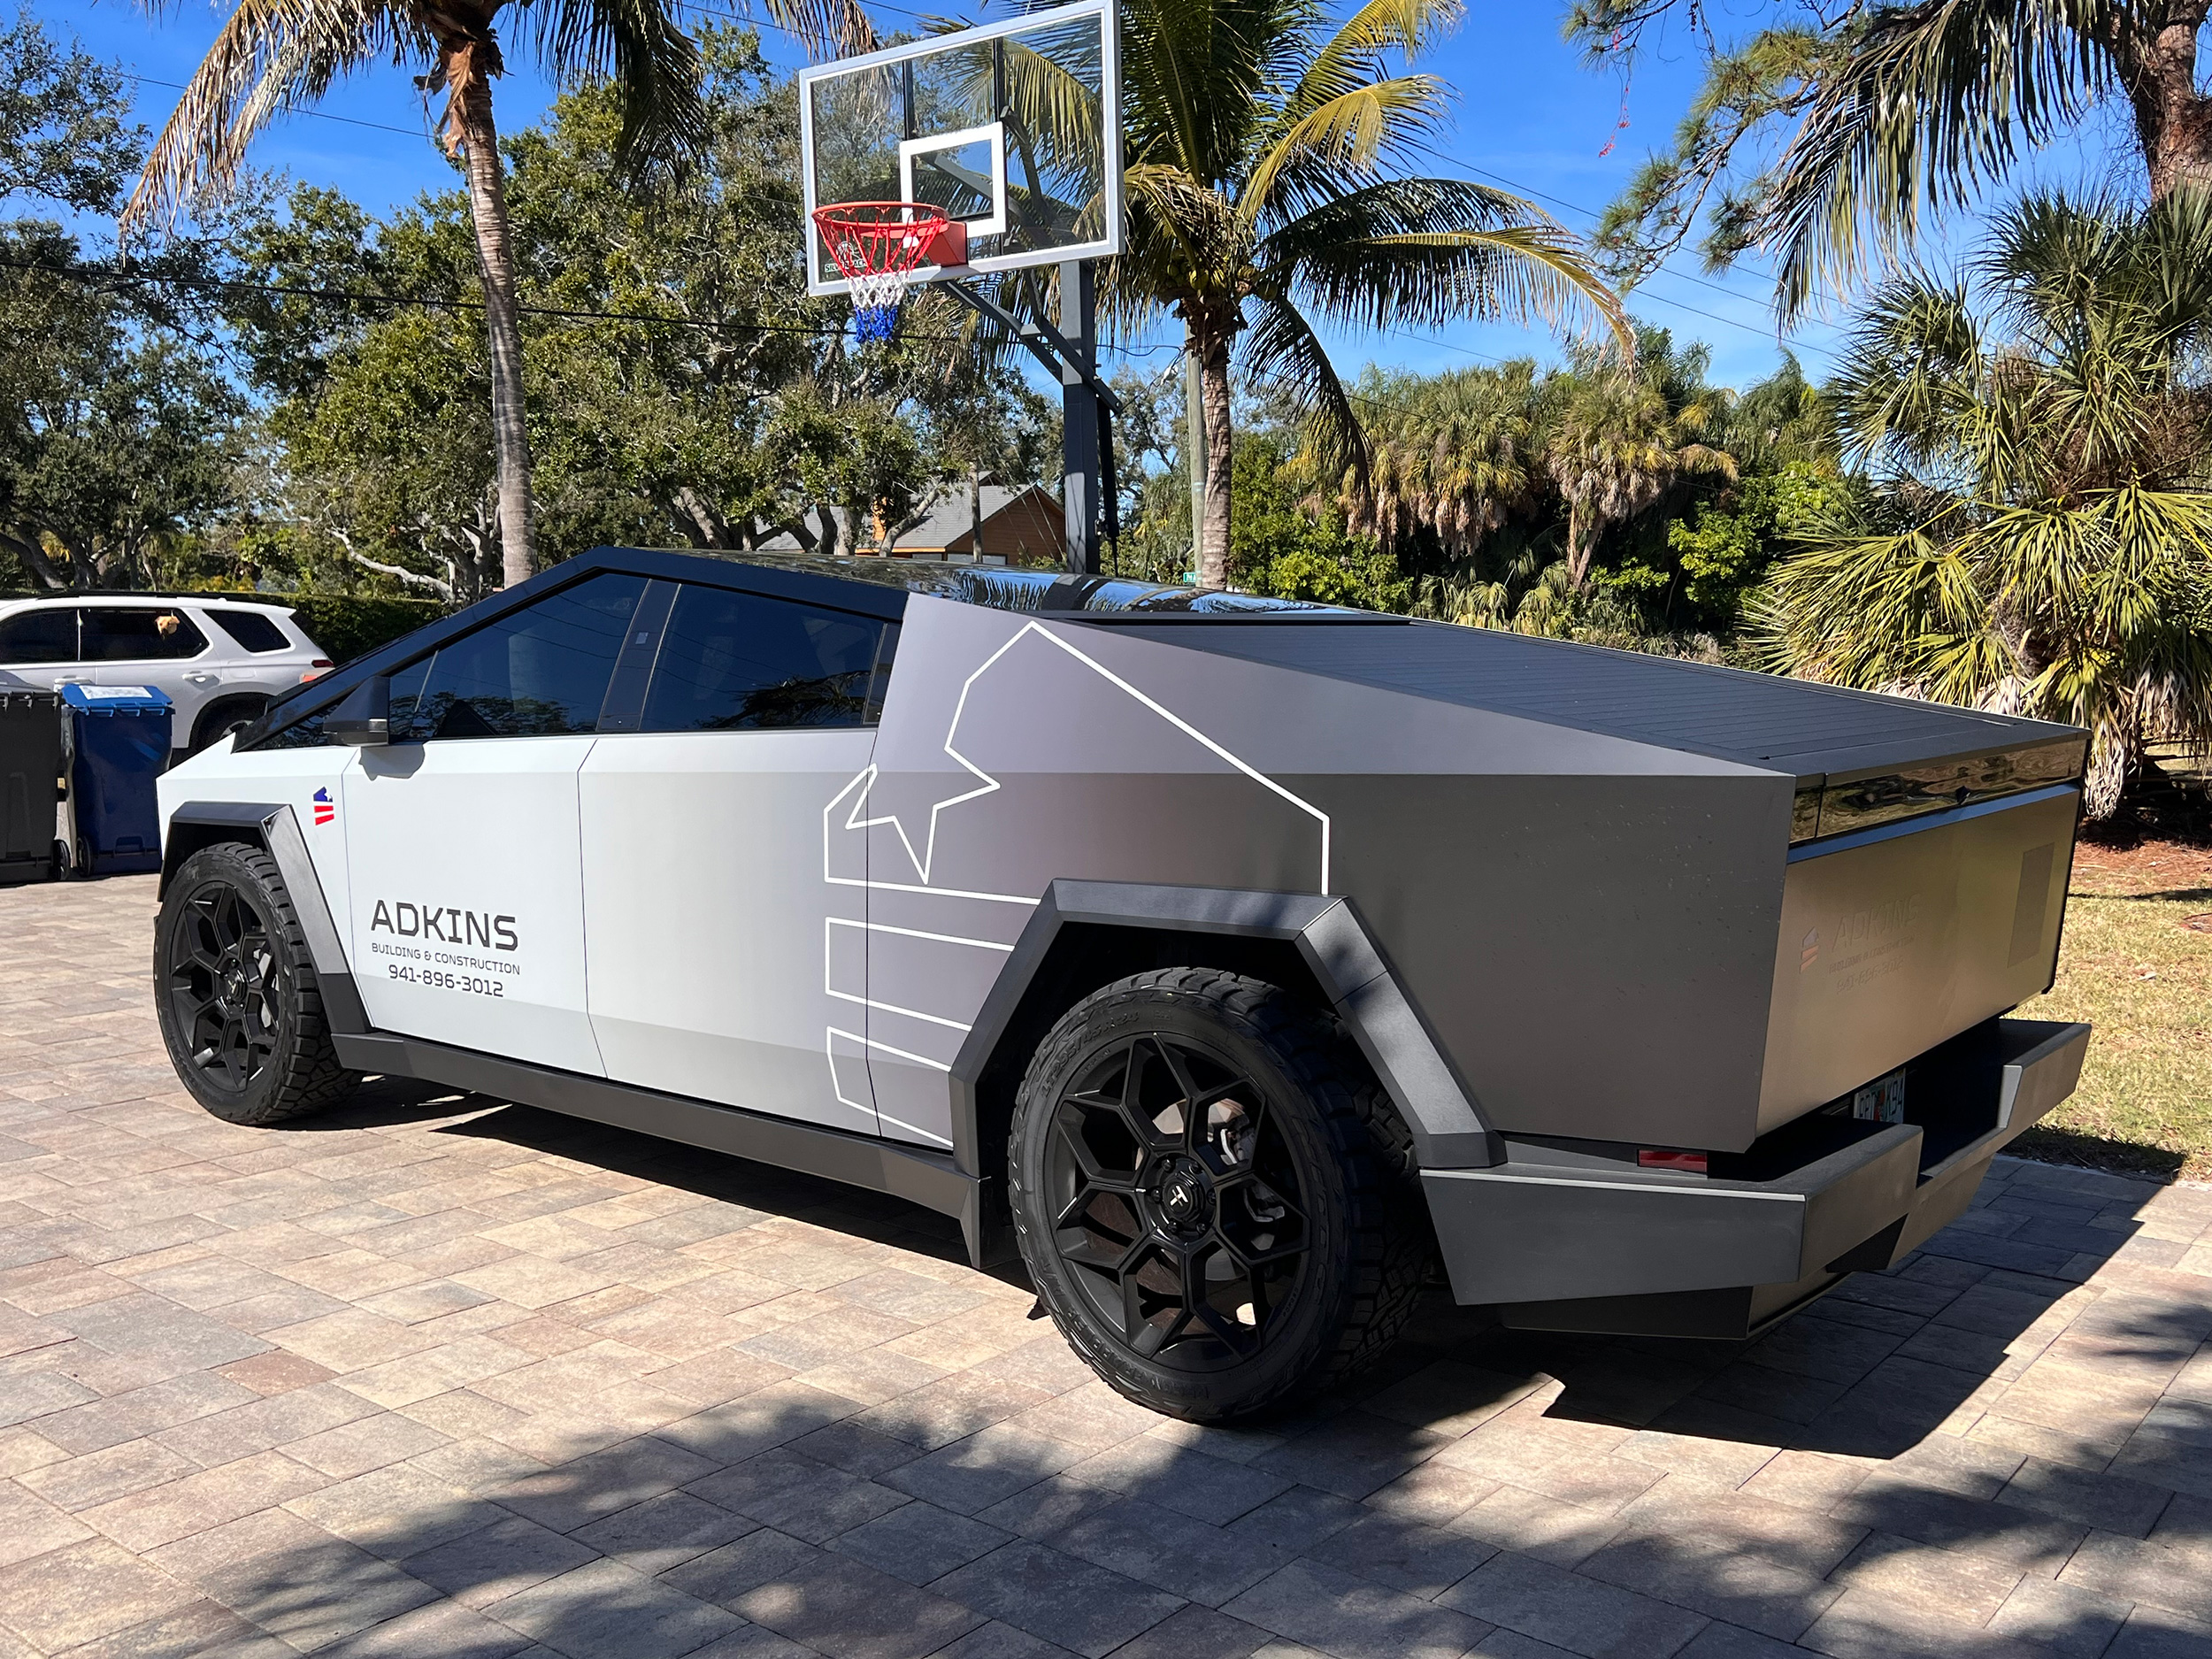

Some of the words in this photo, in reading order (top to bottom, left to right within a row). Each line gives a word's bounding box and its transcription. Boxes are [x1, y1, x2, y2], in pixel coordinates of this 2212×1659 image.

[371, 899, 518, 951] ADKINS
[372, 942, 421, 959] BUILDING
[424, 951, 432, 961] &
[434, 952, 520, 975] CONSTRUCTION
[388, 964, 504, 997] 941-896-3012
